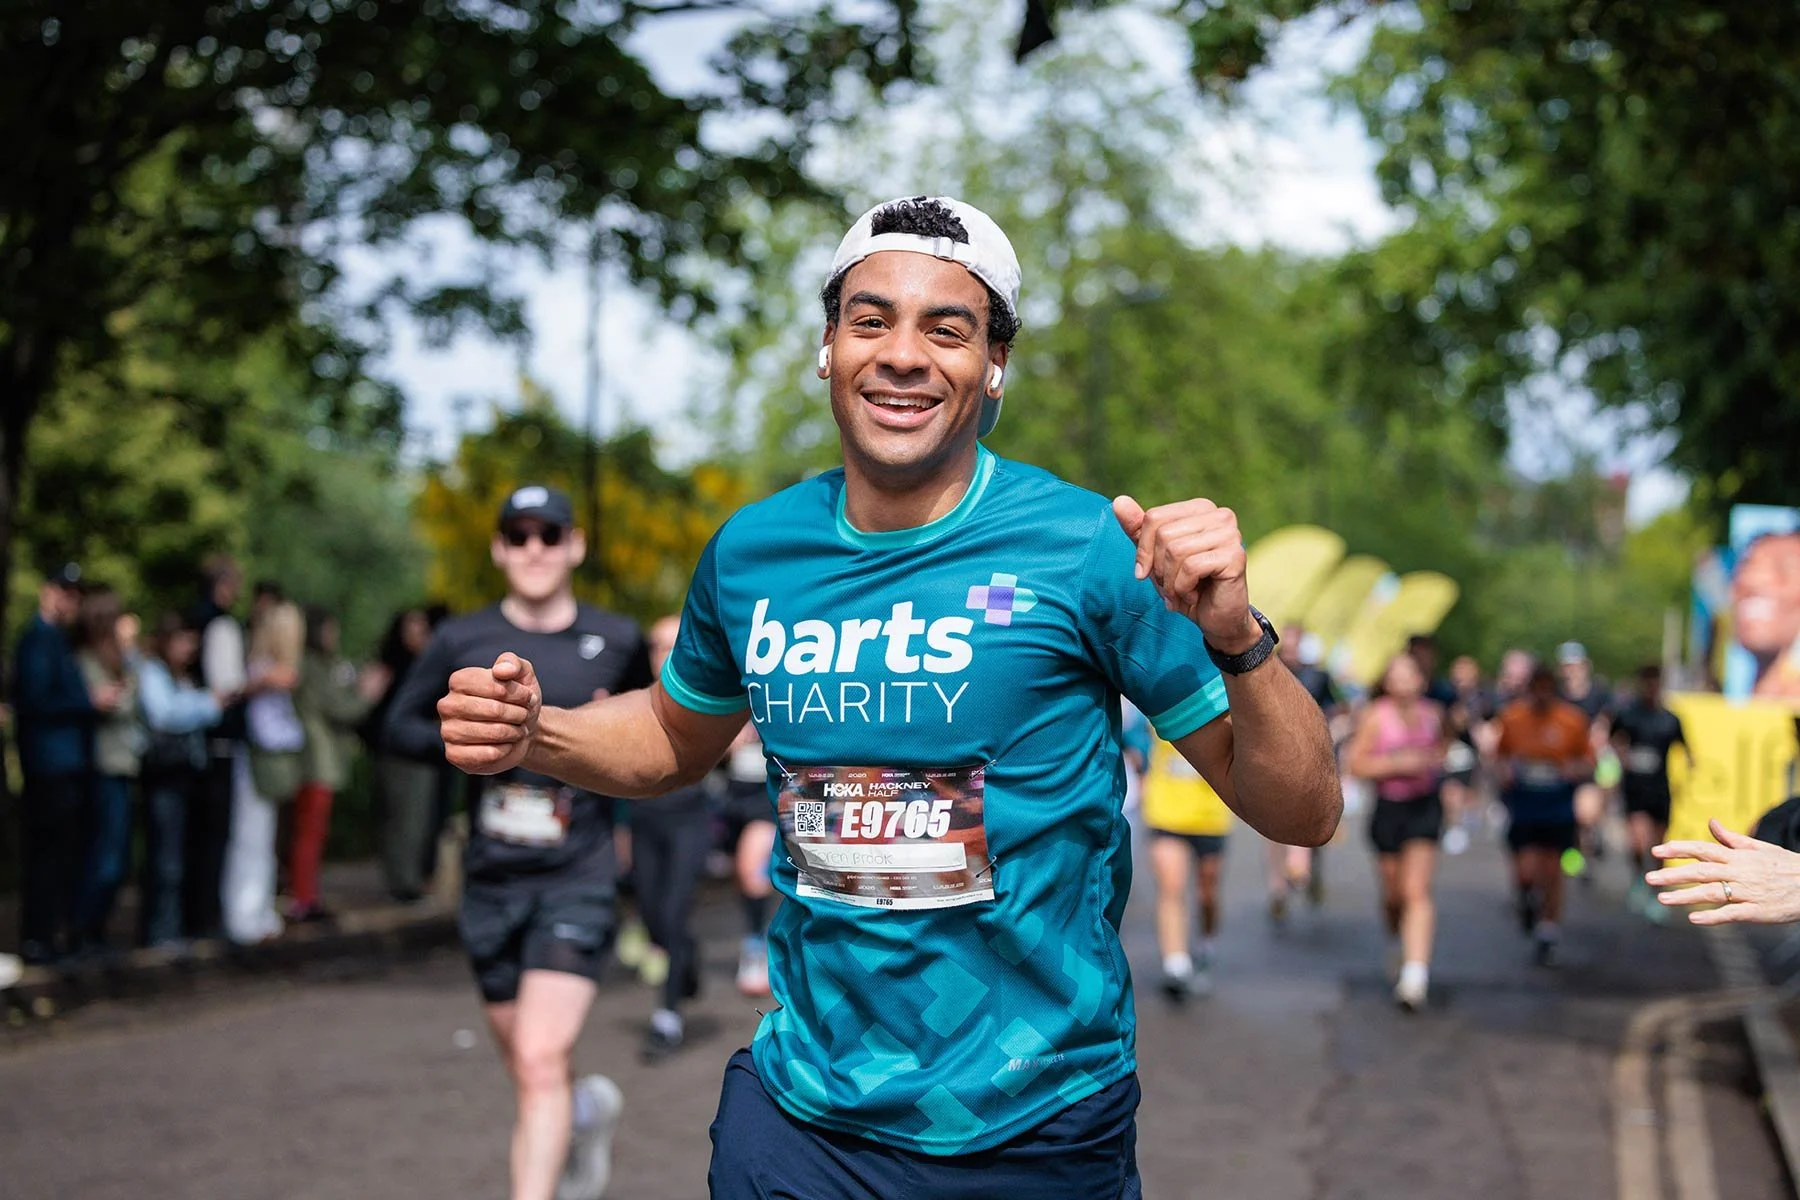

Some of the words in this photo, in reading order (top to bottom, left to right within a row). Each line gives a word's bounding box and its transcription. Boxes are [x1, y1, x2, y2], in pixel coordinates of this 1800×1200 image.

[745, 598, 974, 675] barts
[747, 681, 969, 724] CHARITY
[823, 782, 865, 797] HOKA
[869, 781, 931, 790] HACKNEY
[867, 789, 899, 797] HALF
[840, 800, 953, 839] E9765
[876, 898, 894, 906] E9765
